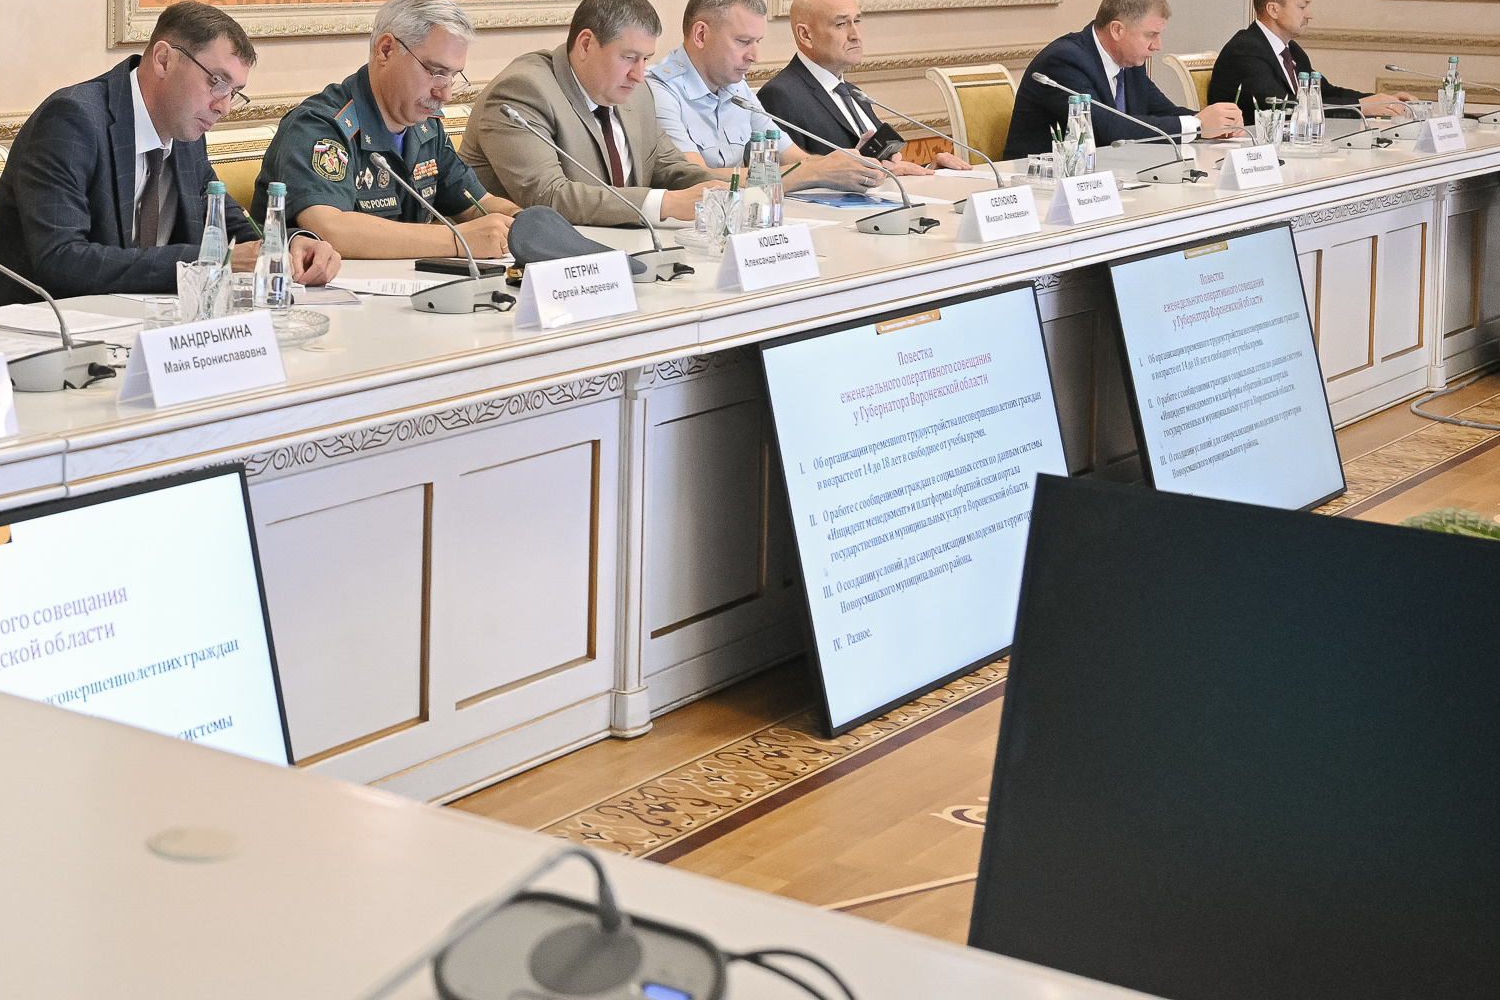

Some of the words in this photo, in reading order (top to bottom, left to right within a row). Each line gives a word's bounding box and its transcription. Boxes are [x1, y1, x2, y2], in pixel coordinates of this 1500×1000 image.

[371, 196, 397, 209] РОССИИ
[990, 194, 1018, 208] СЕЛЮКОВ
[985, 213, 1003, 223] Михаил
[1004, 210, 1029, 220] Алексеевич
[758, 233, 789, 248] КОШЕЛЬ
[744, 255, 776, 268] Александр
[776, 249, 810, 261] Николаевич
[564, 262, 600, 279] ПЕТРИН
[552, 286, 579, 301] Сергей
[580, 281, 619, 295] Андреевич
[169, 324, 252, 350] МАНДРЫКИНА
[164, 361, 191, 374] Майя
[193, 346, 267, 370] Брониславовна
[897, 347, 933, 365] Повестка
[840, 378, 901, 403] еженедельного
[901, 363, 953, 386] оперативного
[953, 352, 992, 372] совещания
[852, 410, 858, 426] у
[859, 396, 910, 422] Губернатора
[909, 379, 959, 406] Воронежской
[959, 373, 989, 391] области
[1003, 508, 1032, 528] территор
[33, 586, 128, 626] совещания
[44, 622, 116, 656] области
[832, 637, 843, 652] IV.
[846, 628, 872, 646] Разное.
[43, 656, 182, 706] есовершеннолетних
[184, 639, 239, 669] граждан
